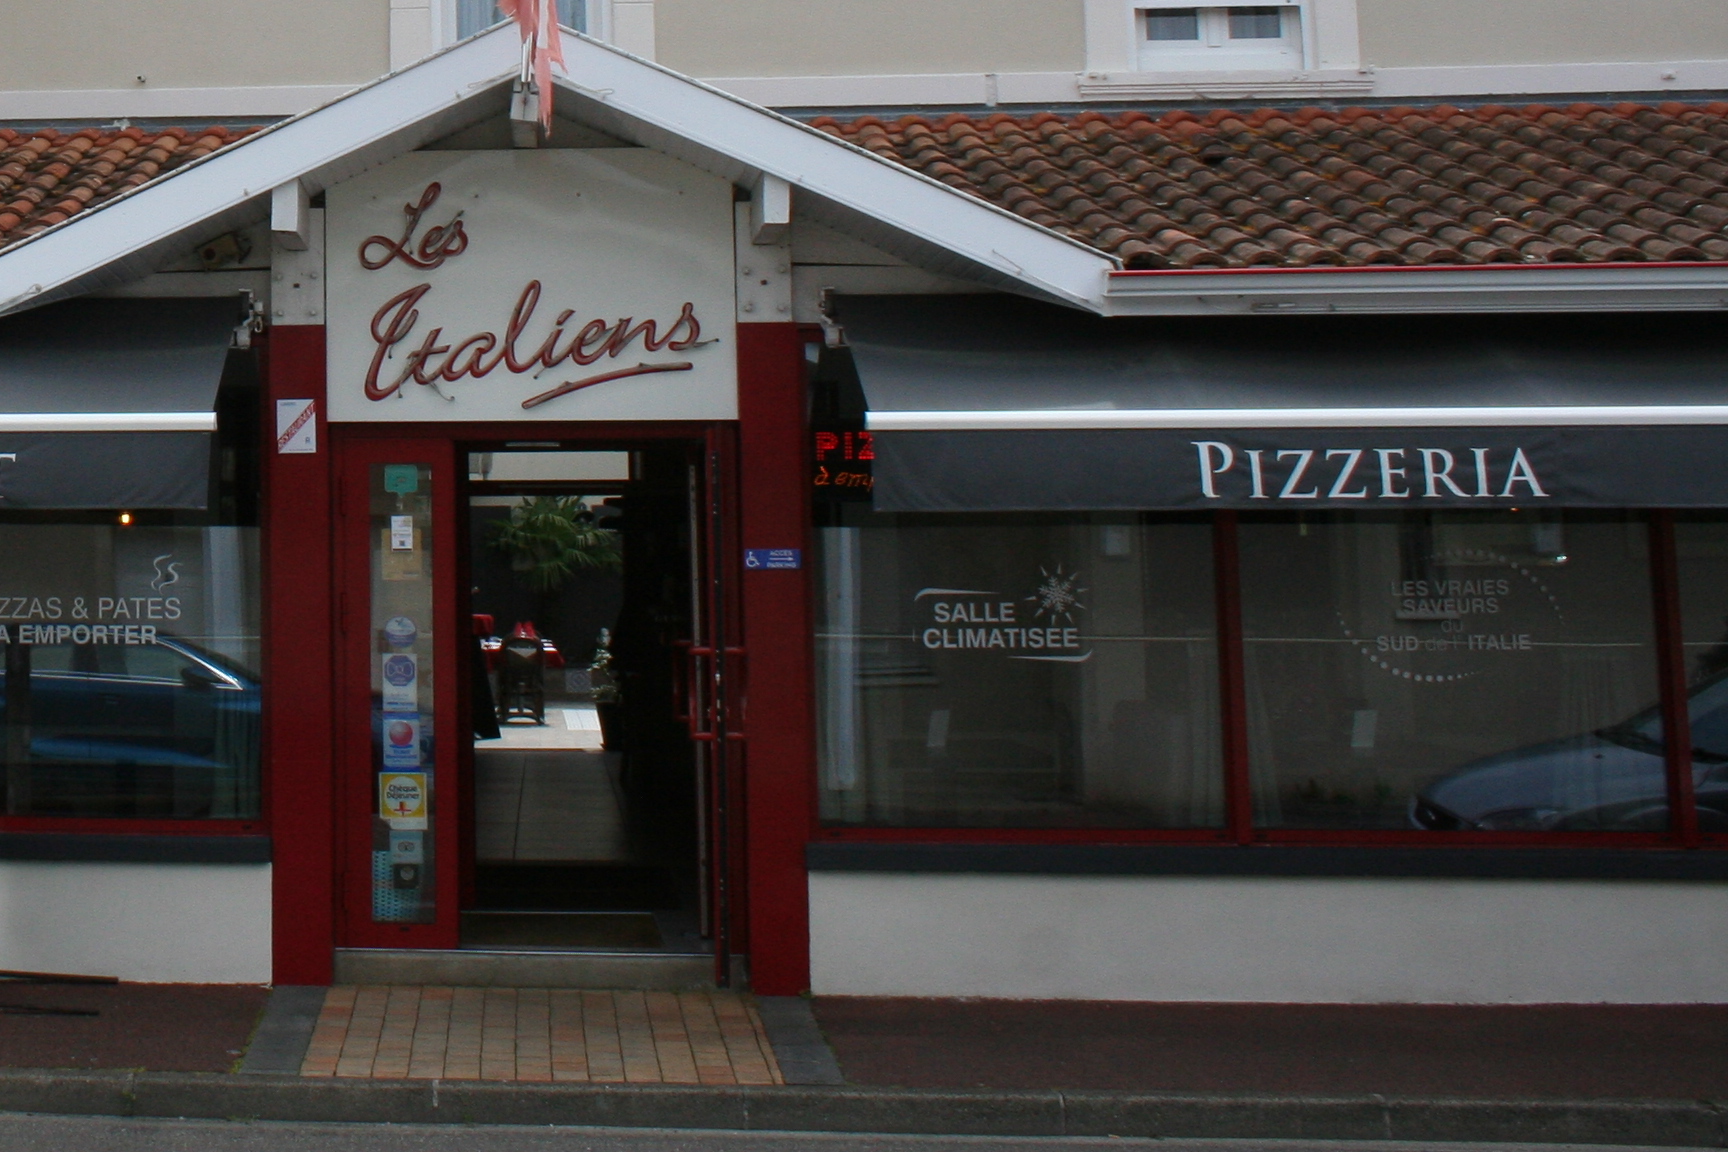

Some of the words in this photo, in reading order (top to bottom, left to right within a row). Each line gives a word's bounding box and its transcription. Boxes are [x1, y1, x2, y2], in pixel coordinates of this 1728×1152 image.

[358, 181, 469, 270] Les
[363, 279, 703, 401] Italiens
[1190, 440, 1550, 499] PIZZERIA
[1391, 581, 1428, 597] LES
[1435, 579, 1509, 596] VRAIES
[71, 597, 89, 620] &
[98, 597, 182, 620] PATES
[934, 602, 1016, 623] SALLE
[1402, 598, 1499, 614] SAVEURS
[18, 624, 157, 645] EMPORTER
[1440, 619, 1464, 634] du
[923, 628, 1080, 648] CLIMATISEE
[1377, 635, 1420, 652] SUD
[1468, 634, 1532, 651] ITALIE
